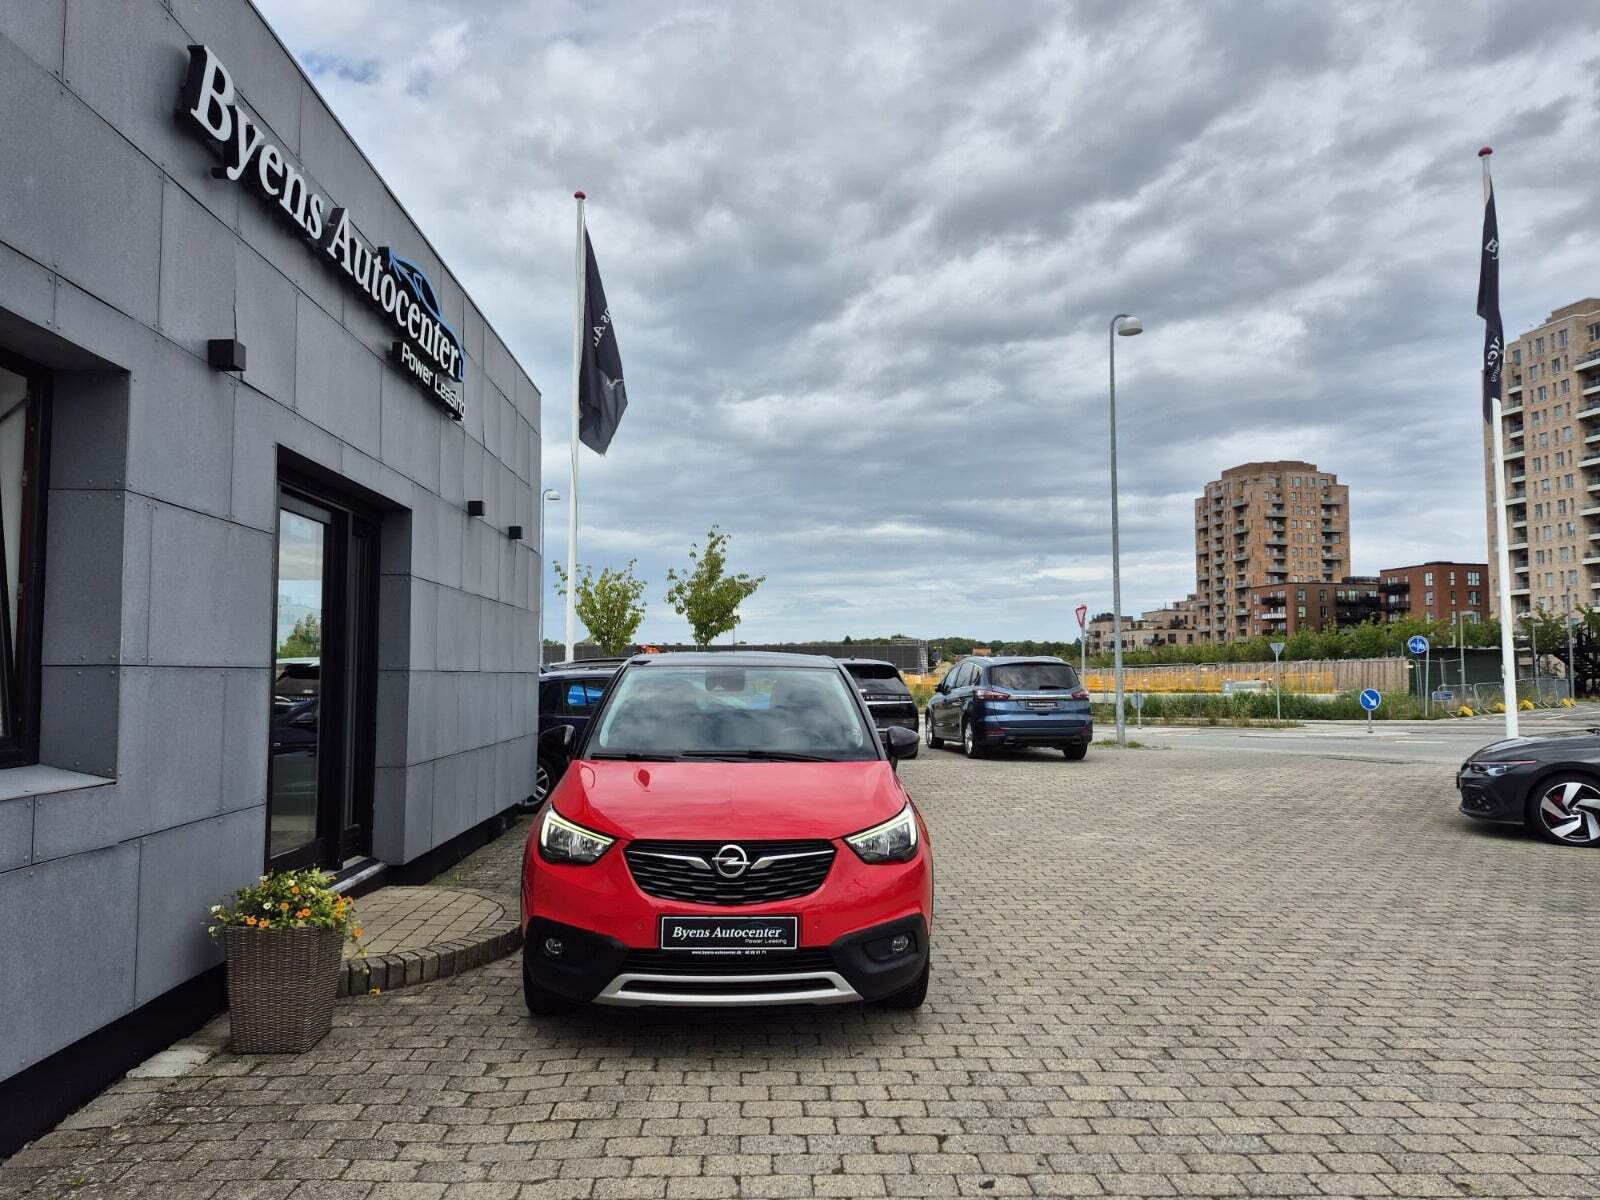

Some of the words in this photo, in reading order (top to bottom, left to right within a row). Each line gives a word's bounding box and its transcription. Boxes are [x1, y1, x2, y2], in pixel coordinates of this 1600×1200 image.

[190, 45, 324, 241] Byens
[326, 207, 460, 379] Autocenter
[401, 341, 434, 387] Power
[434, 373, 466, 421] Leasing
[672, 926, 710, 941] Byens
[711, 926, 782, 938] Autocenter
